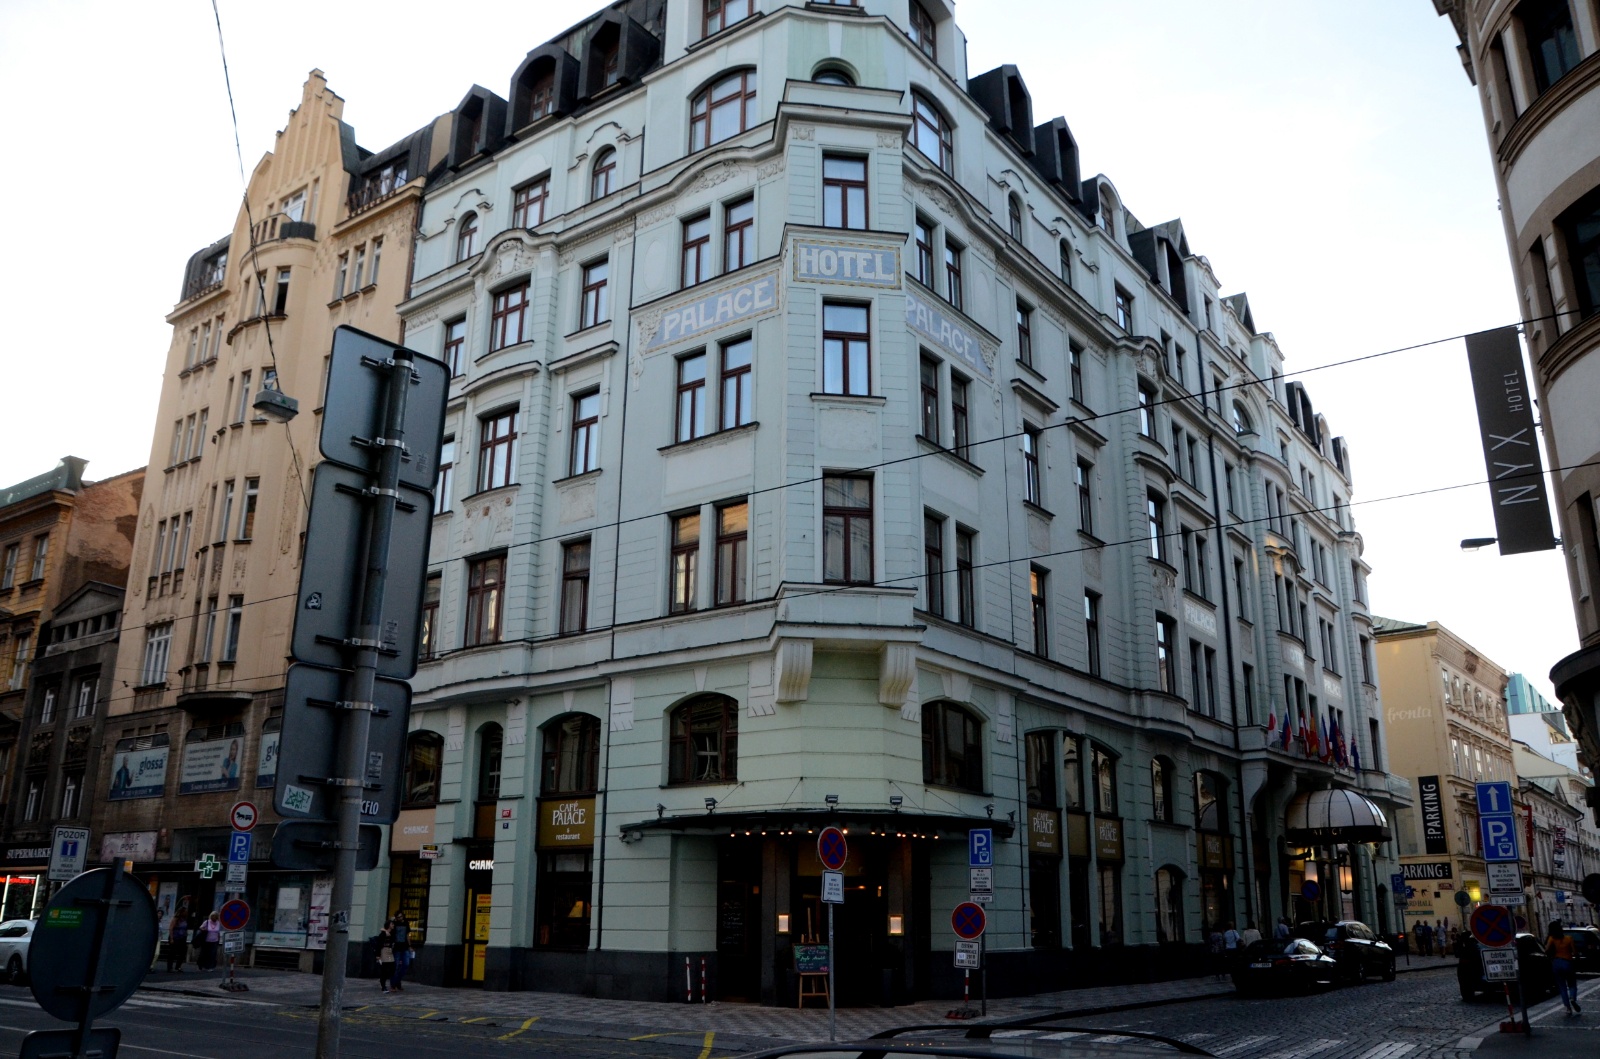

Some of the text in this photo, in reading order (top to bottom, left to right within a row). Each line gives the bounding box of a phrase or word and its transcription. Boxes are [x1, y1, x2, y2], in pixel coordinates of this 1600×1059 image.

[799, 247, 895, 281] HOTEL
[663, 281, 772, 341] PALACE
[905, 295, 976, 365] PALACE
[1489, 369, 1540, 506] NYX HOTEL
[139, 757, 163, 775] glossa
[559, 801, 579, 812] CAFÉ
[1422, 784, 1441, 835] PARKING
[552, 809, 586, 825] PALACE
[1033, 817, 1054, 834] PALACE
[58, 831, 85, 839] POZOR
[403, 825, 429, 835] CHANGE
[556, 833, 580, 841] restaurant
[1099, 826, 1117, 841] PALACE
